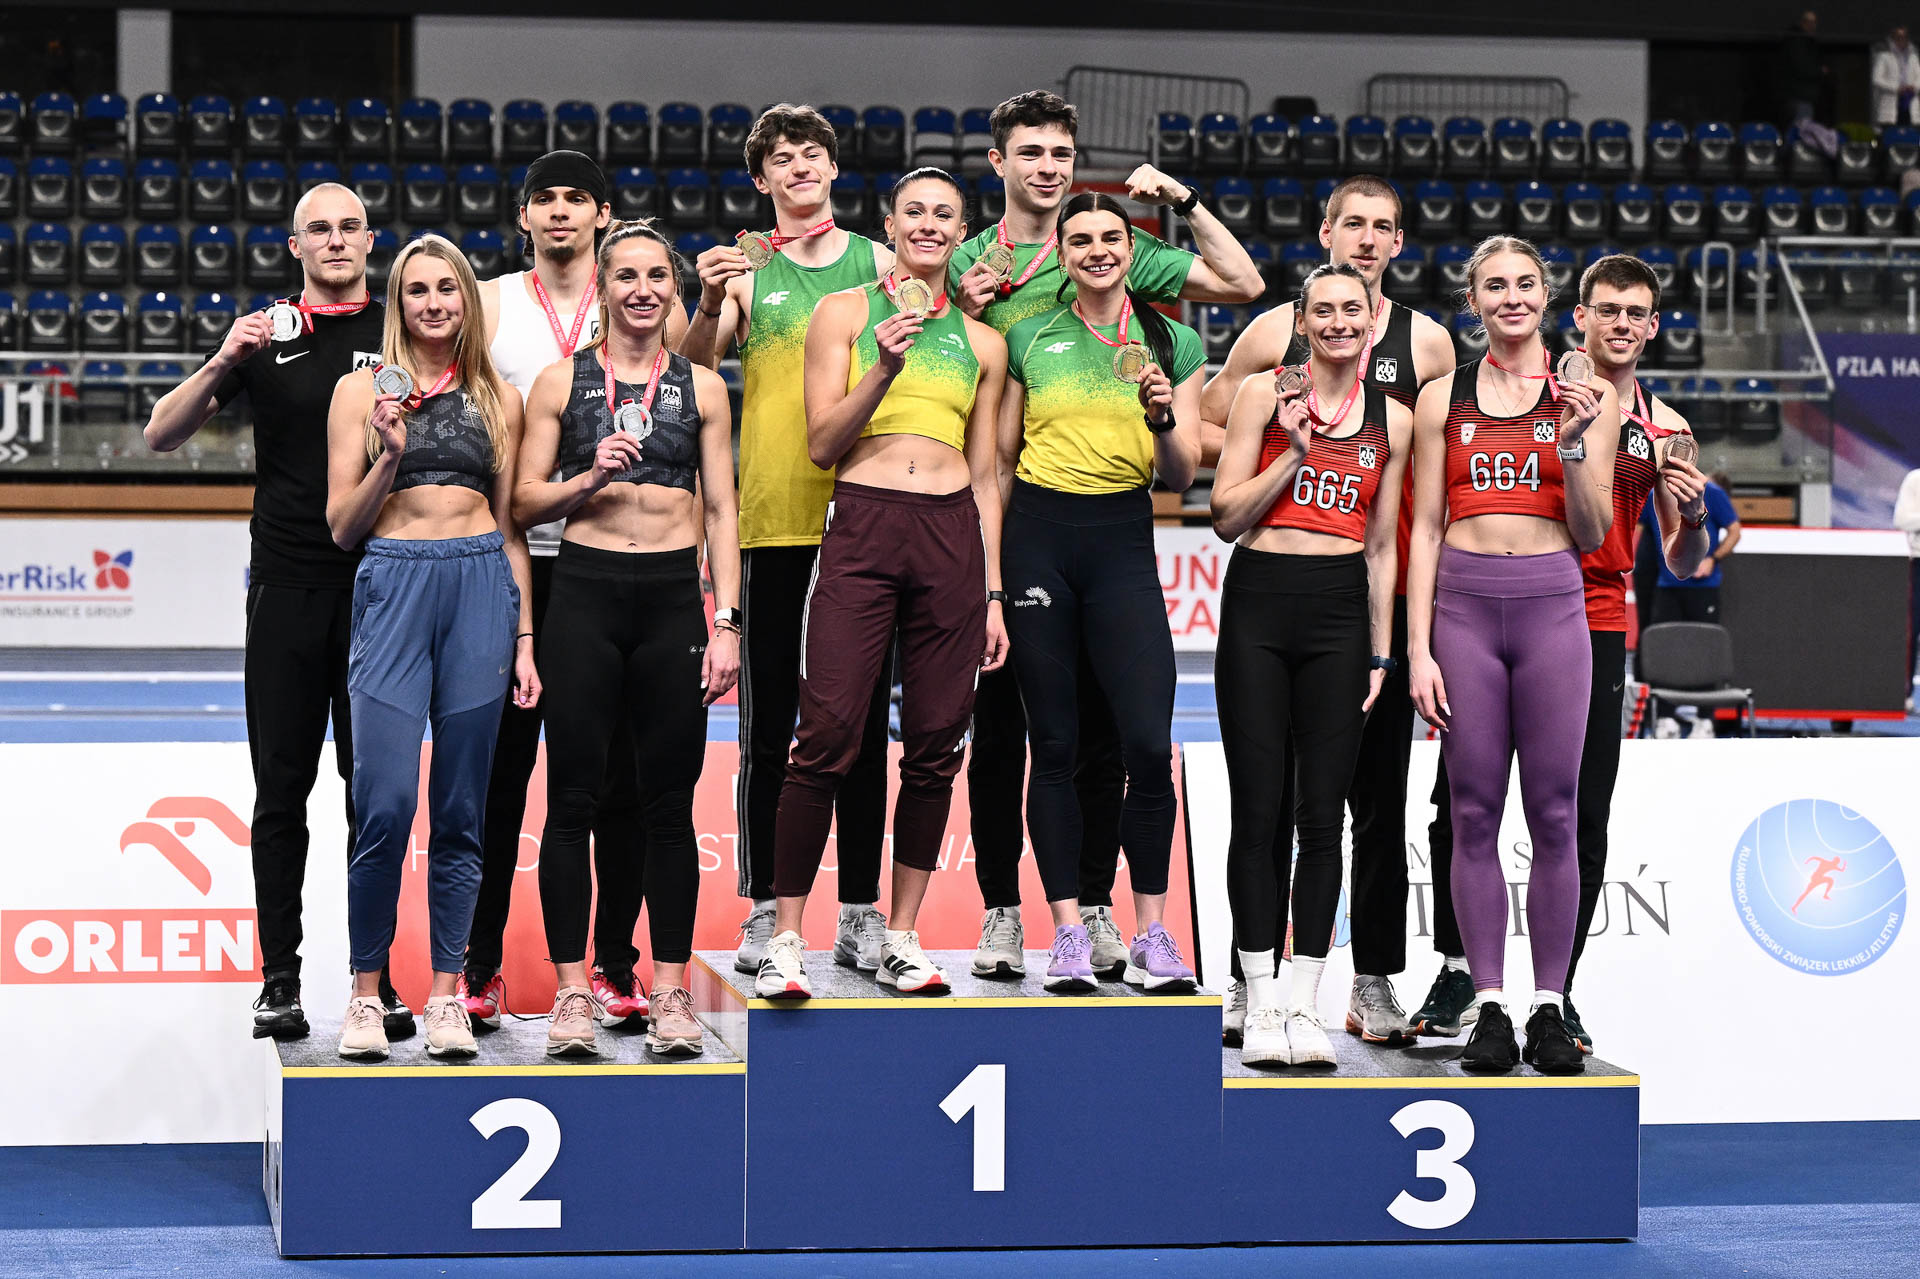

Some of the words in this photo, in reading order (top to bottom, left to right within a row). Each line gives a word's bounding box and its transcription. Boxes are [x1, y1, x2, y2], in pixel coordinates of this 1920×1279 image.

[762, 291, 790, 305] 4F
[1044, 342, 1076, 353] 4F
[1836, 356, 1886, 377] PZLA
[584, 388, 606, 399] JAK
[1292, 465, 1362, 514] 665
[1469, 451, 1542, 492] 664
[14, 919, 254, 974] ORLEN
[939, 1065, 1005, 1191] 1
[469, 1098, 561, 1228] 2
[1387, 1100, 1475, 1229] 3
